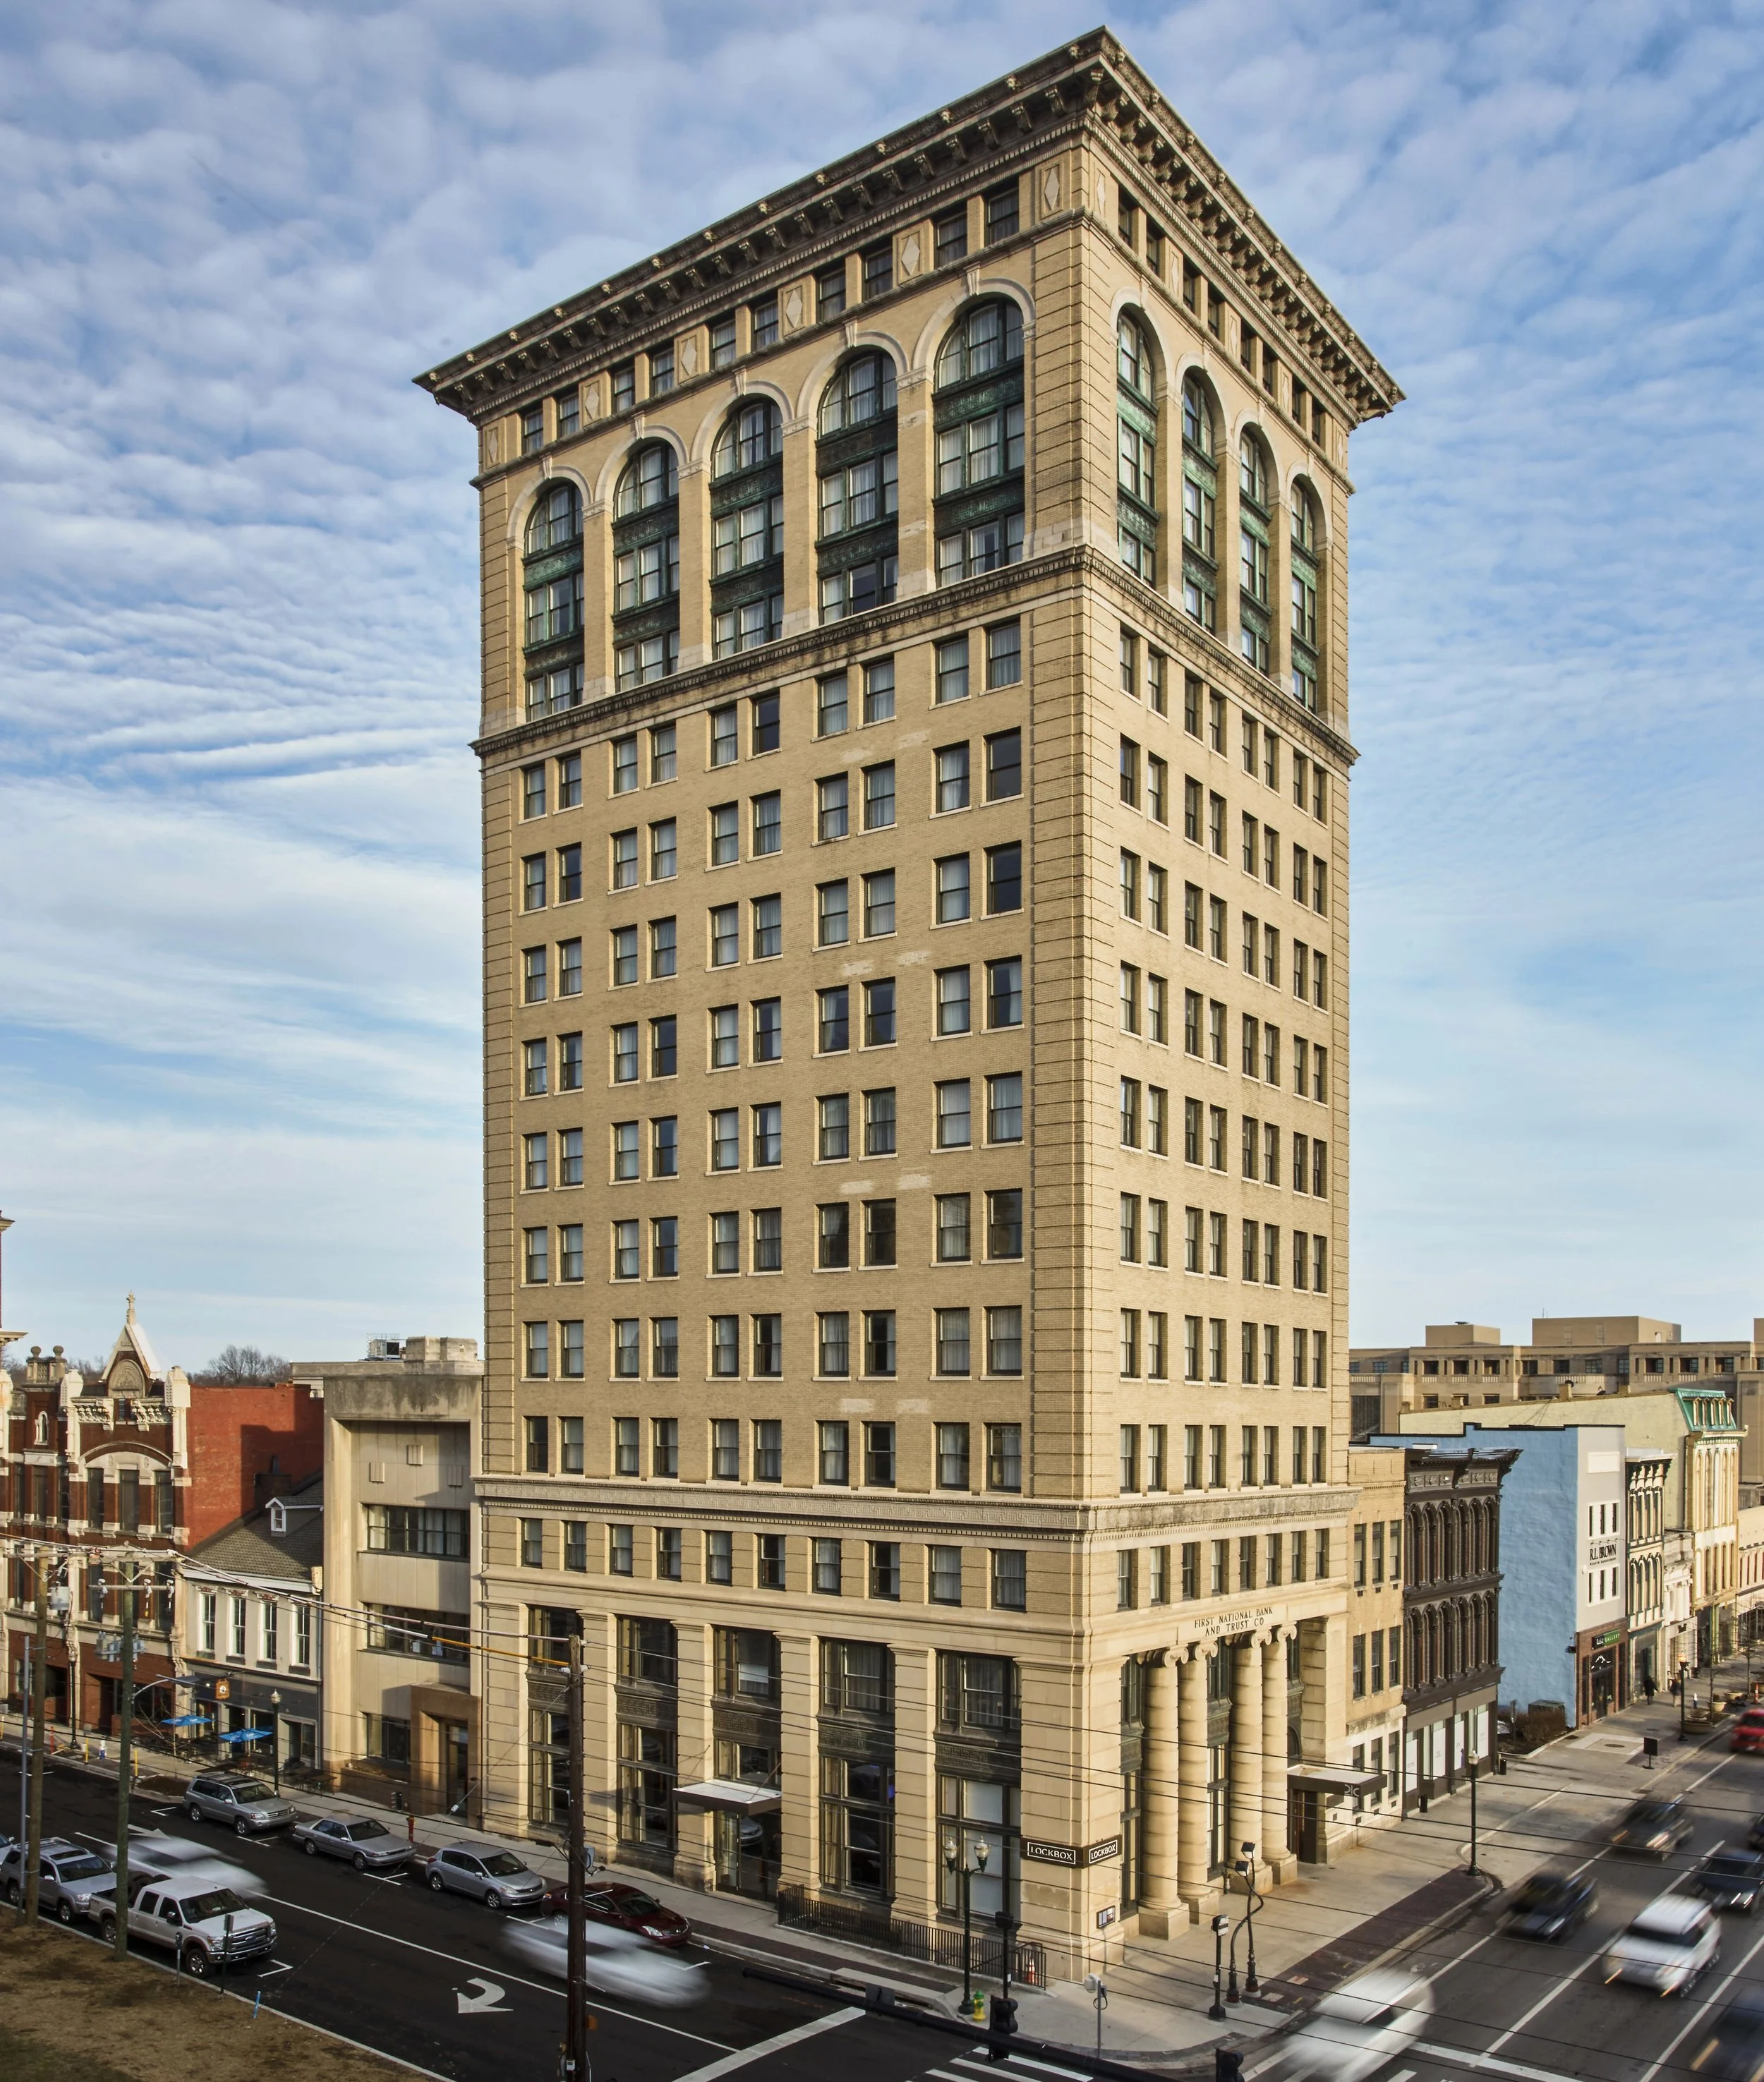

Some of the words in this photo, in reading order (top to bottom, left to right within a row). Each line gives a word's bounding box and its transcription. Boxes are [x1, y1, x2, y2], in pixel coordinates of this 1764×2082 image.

[1599, 1544, 1617, 1559] BROWN
[1195, 1617, 1214, 1628] FIRST
[1219, 1610, 1252, 1624] NATIONAL
[1256, 1606, 1273, 1617] BANK
[1205, 1626, 1221, 1636] AND
[1226, 1620, 1249, 1632] TRUST
[1254, 1617, 1264, 1626] CO
[1605, 1633, 1620, 1642] GALLERY
[1031, 1846, 1073, 1860] LOCKBOX
[1091, 1844, 1116, 1860] LOCKBOX
